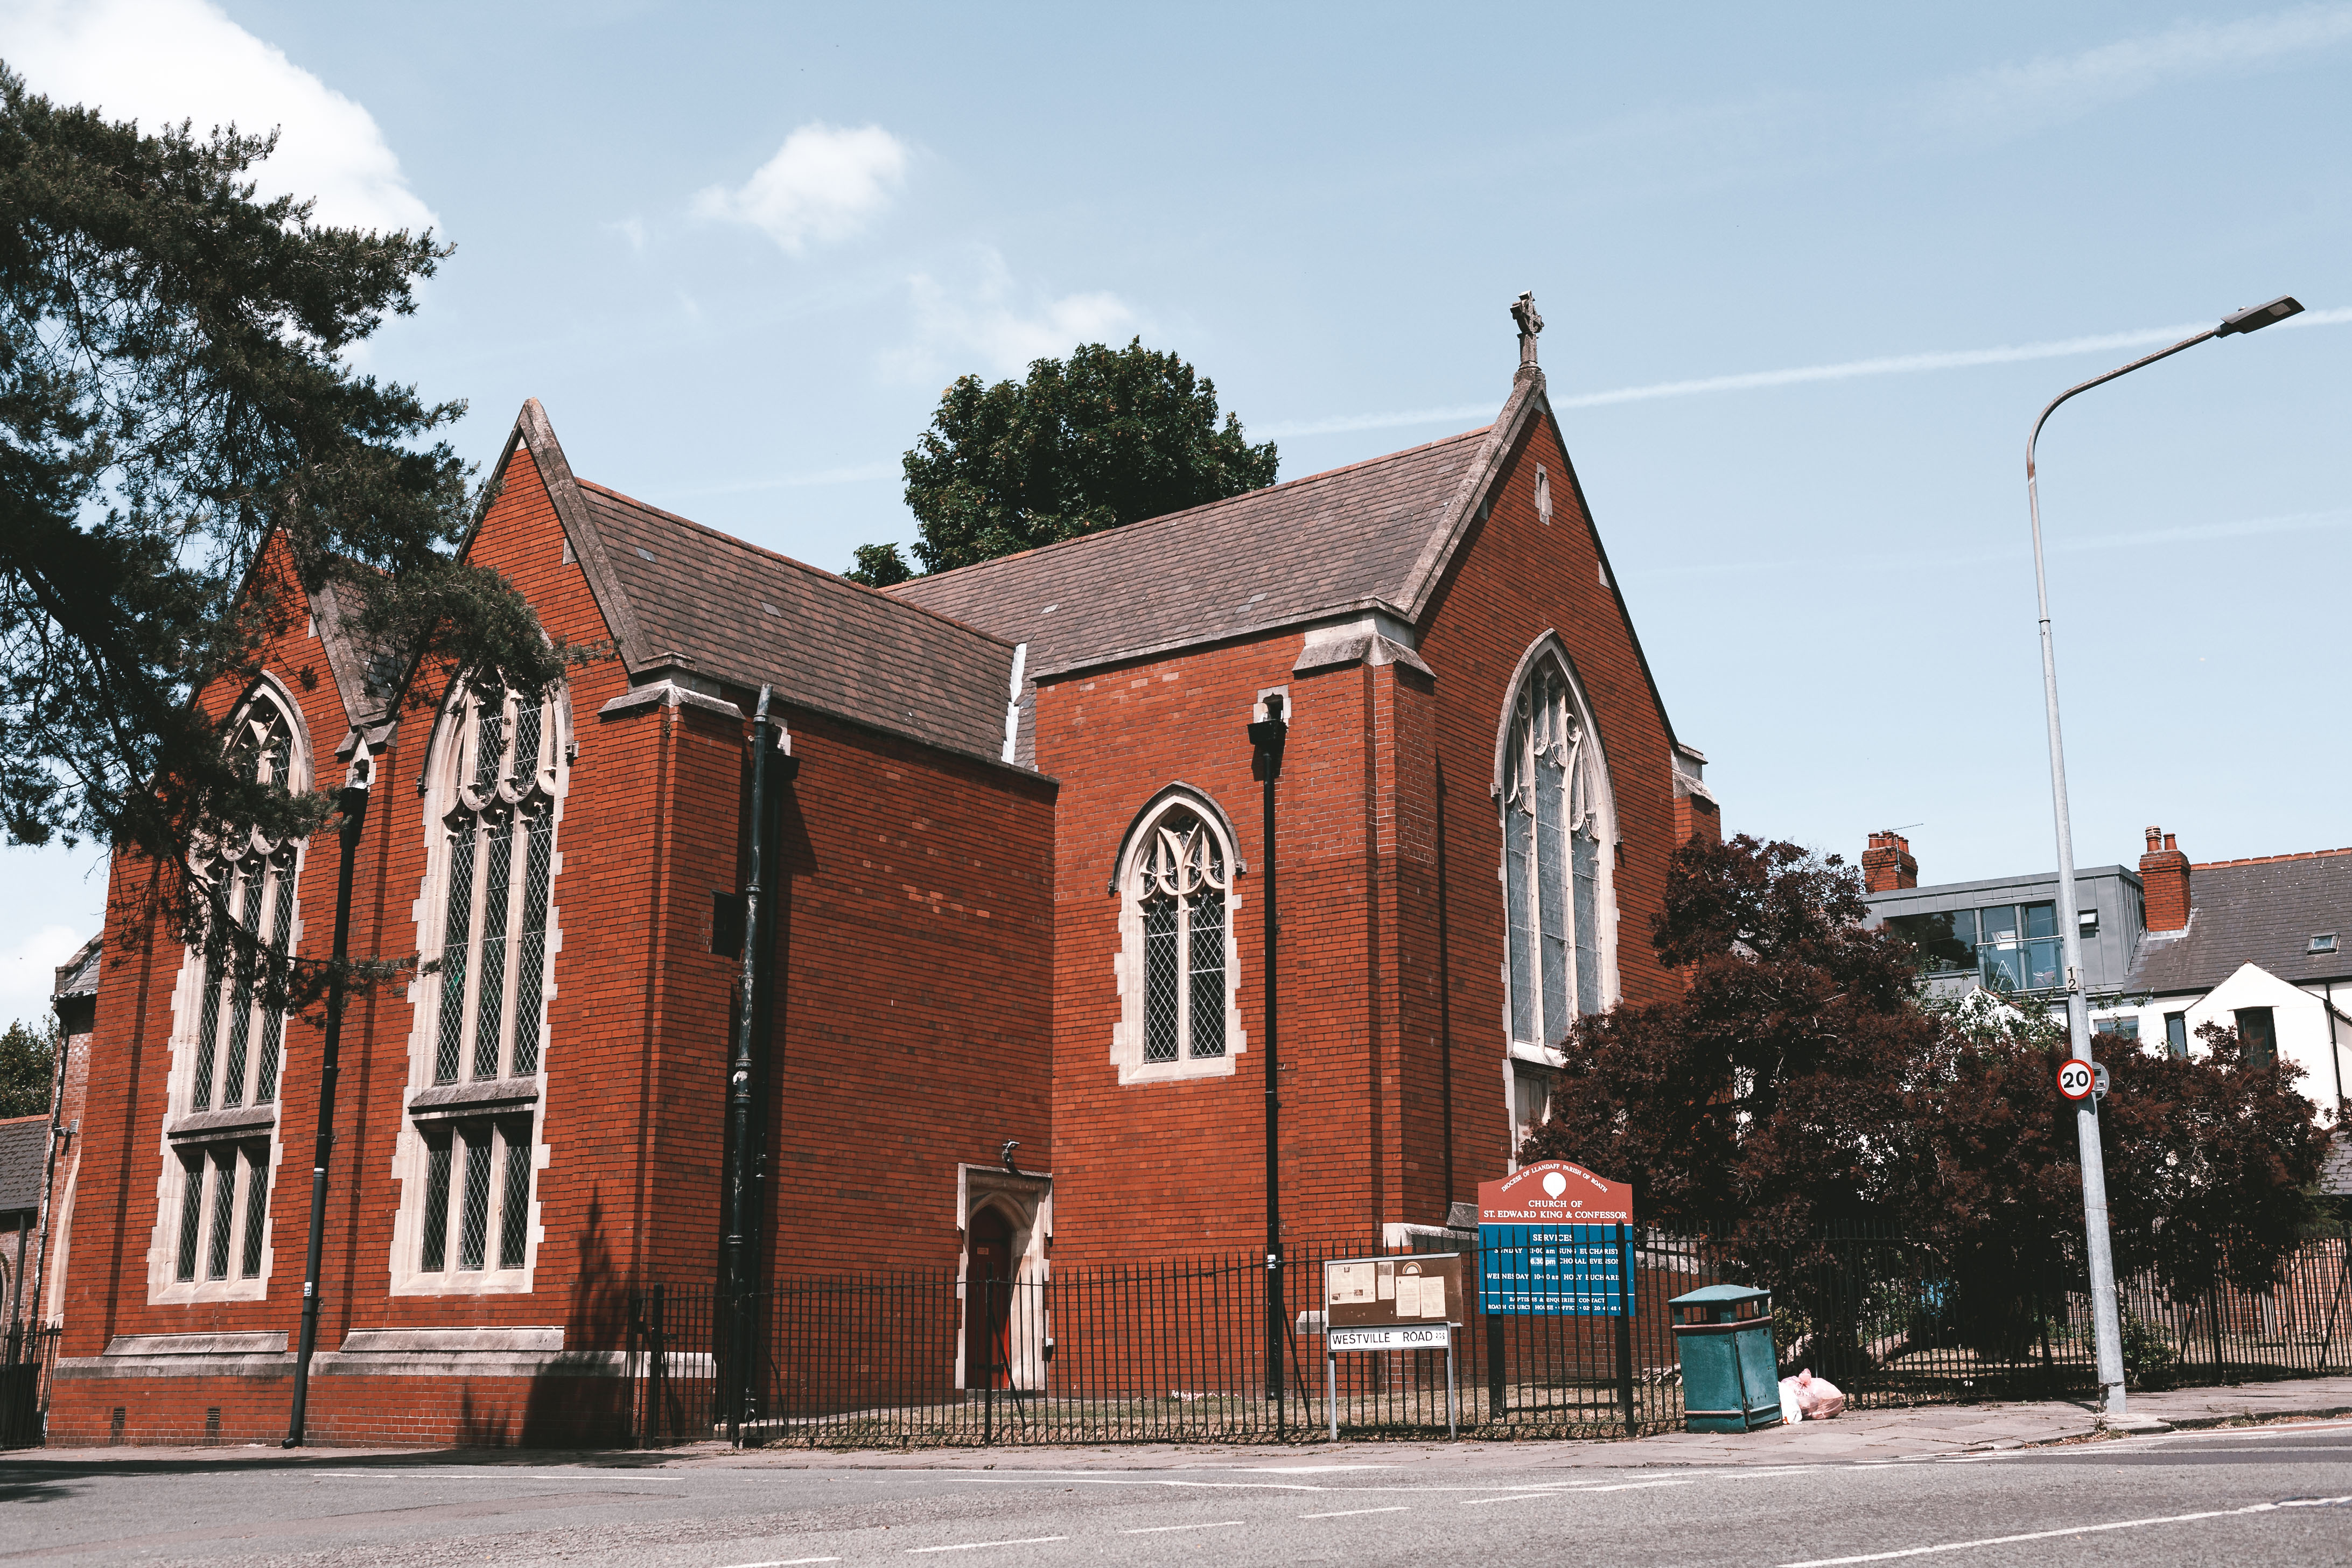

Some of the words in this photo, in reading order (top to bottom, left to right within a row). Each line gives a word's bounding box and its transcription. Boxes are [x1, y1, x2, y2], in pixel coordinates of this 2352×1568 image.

[2062, 1070, 2089, 1088] 20
[1501, 1174, 1523, 1192] DIOCESE
[1522, 1170, 1530, 1178] OF
[1531, 1163, 1560, 1174] LLANDAFF
[1562, 1164, 1582, 1176] PARISH
[1590, 1177, 1608, 1193] ROATH
[1528, 1200, 1567, 1208] CHURCH
[1483, 1210, 1496, 1218] ST.
[1497, 1210, 1537, 1218] EDWARD
[1540, 1210, 1563, 1219] KING
[1574, 1210, 1628, 1219] CONFESSOR
[1532, 1234, 1572, 1242] SERVICES
[1332, 1333, 1390, 1345] WESTVILLE
[1403, 1331, 1433, 1342] ROAD
